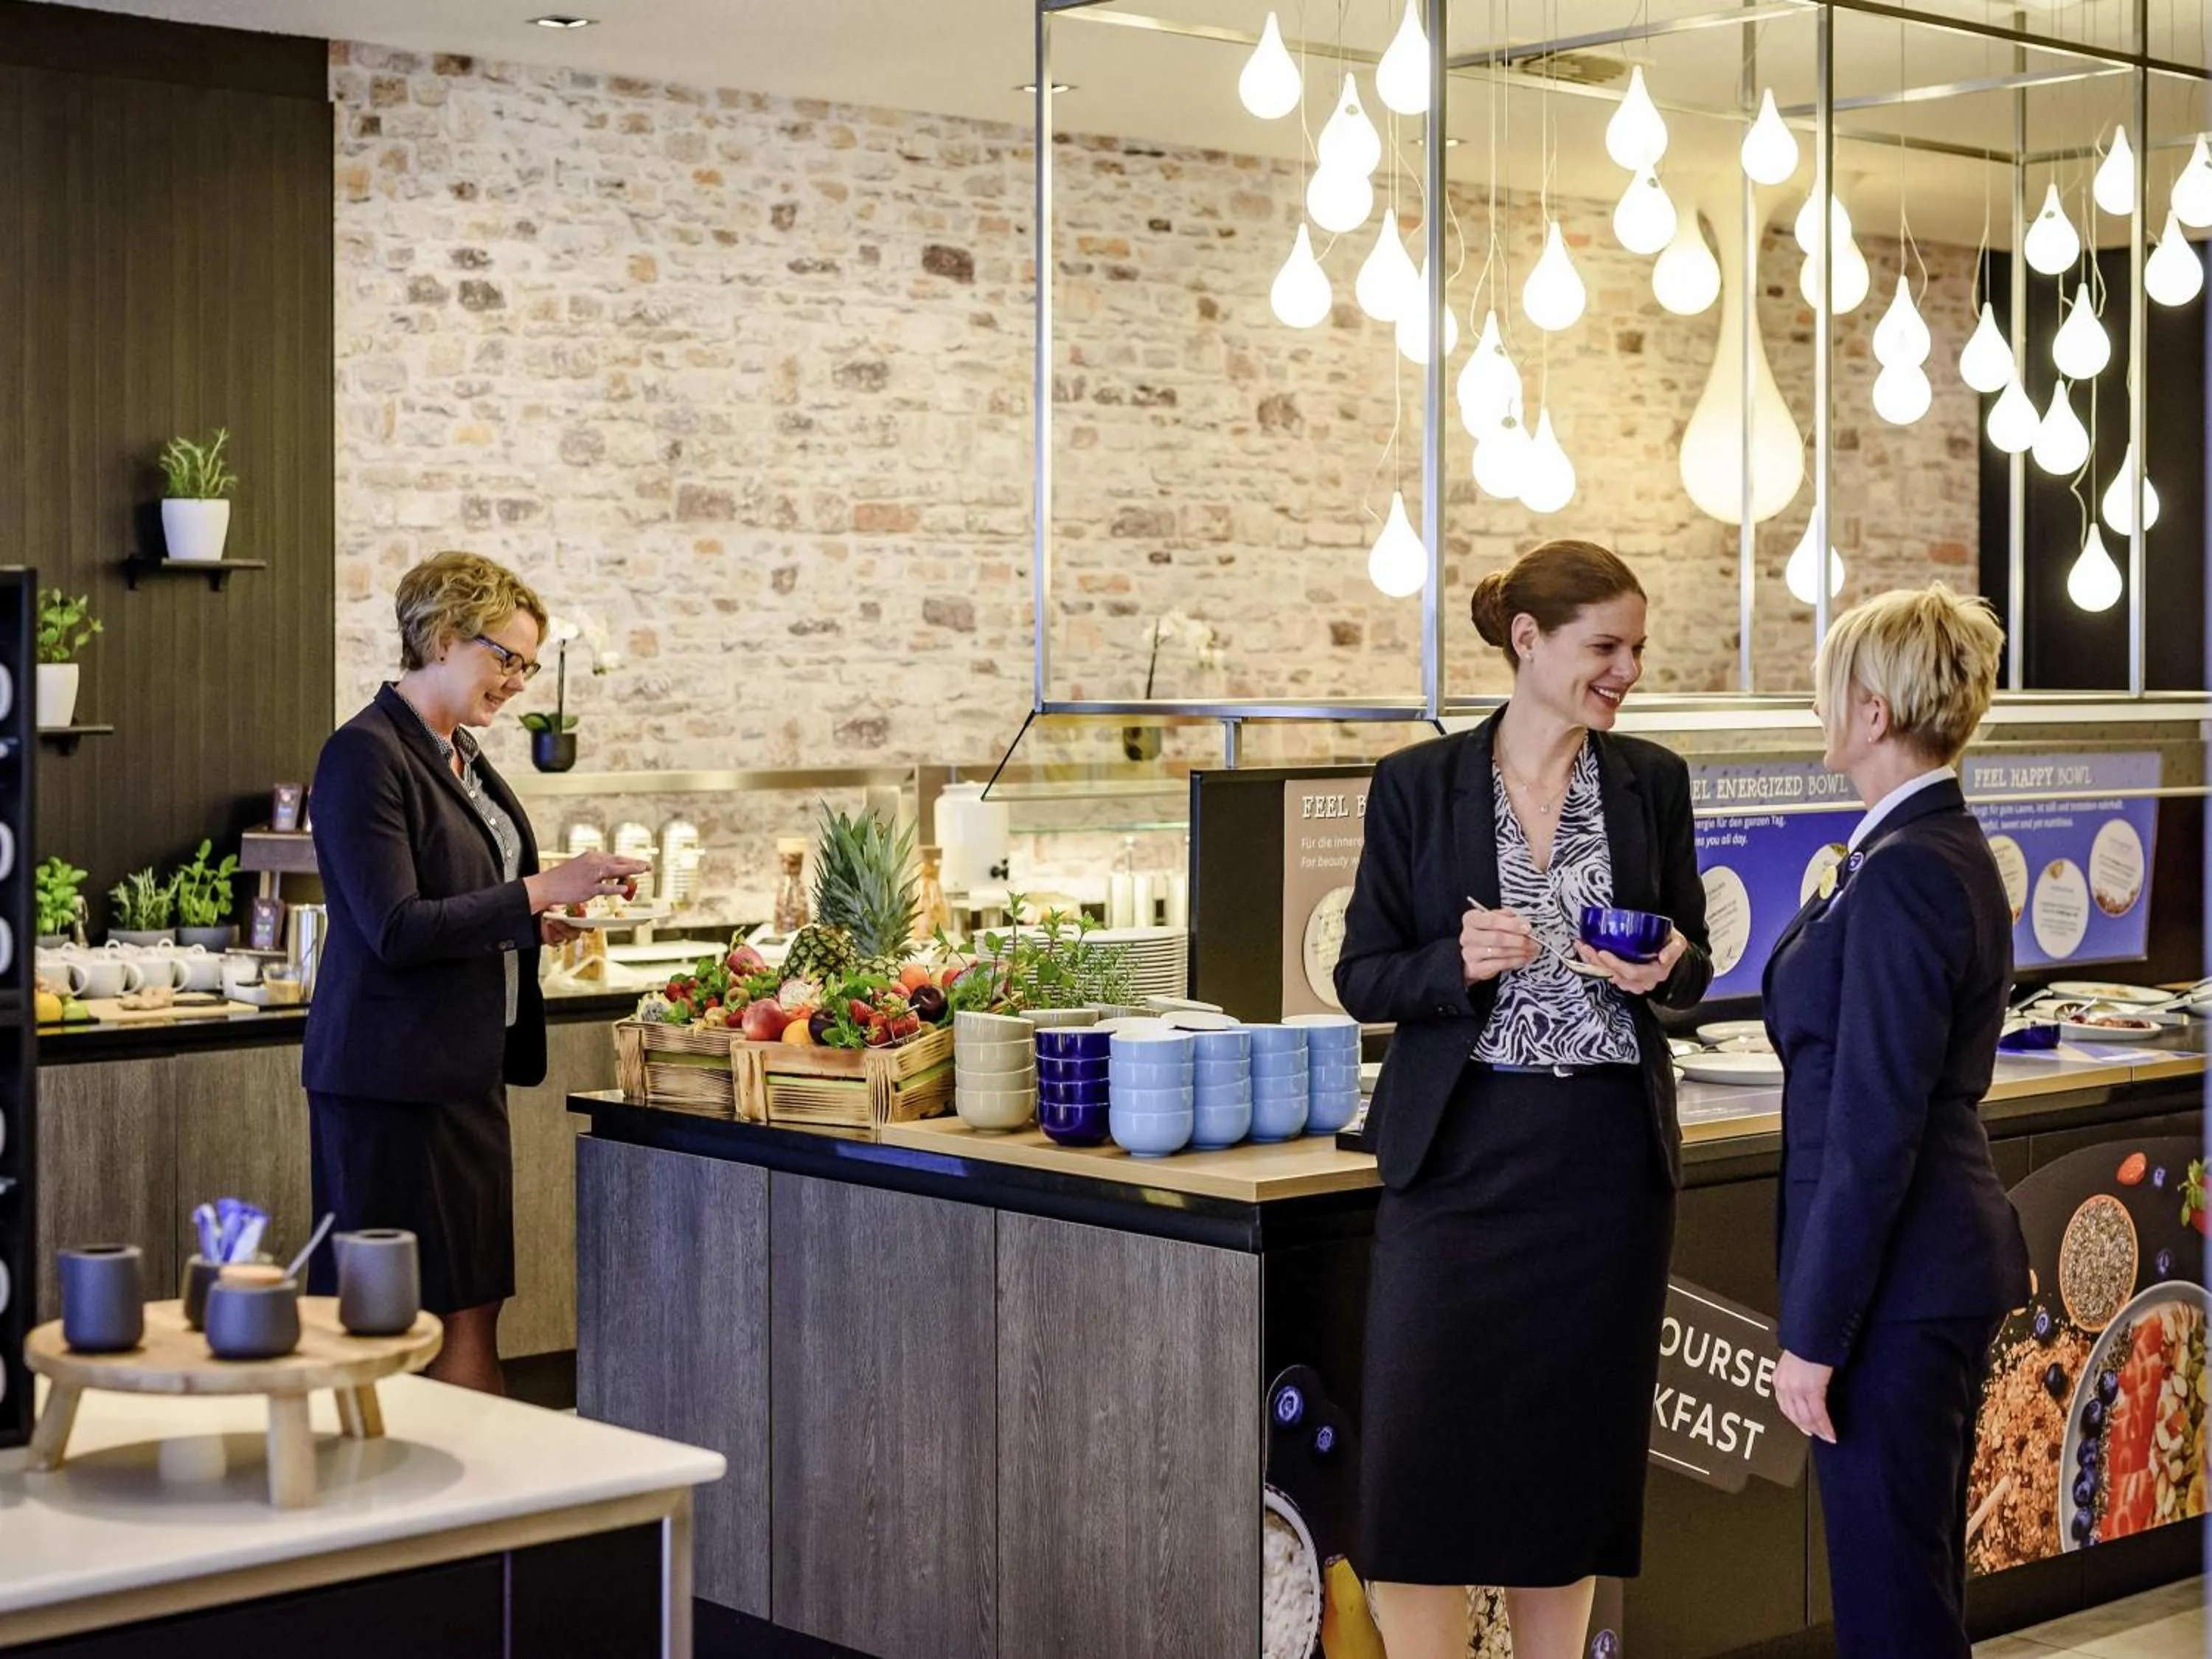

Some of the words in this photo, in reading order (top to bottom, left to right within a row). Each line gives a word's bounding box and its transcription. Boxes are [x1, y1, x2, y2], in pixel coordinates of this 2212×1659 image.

[1691, 778, 1711, 800] EL
[1717, 775, 1804, 799] ENERGIZED
[1807, 773, 1848, 796] BOWL
[1974, 767, 2007, 788] FEEL
[2010, 766, 2054, 787] HAPPY
[2057, 765, 2093, 785] BOWL
[1301, 795, 1350, 819] FEEL
[1301, 836, 1315, 849] Für
[1318, 836, 1332, 848] die
[1659, 1316, 1776, 1398] OURSE
[1653, 1383, 1764, 1460] KFAST
